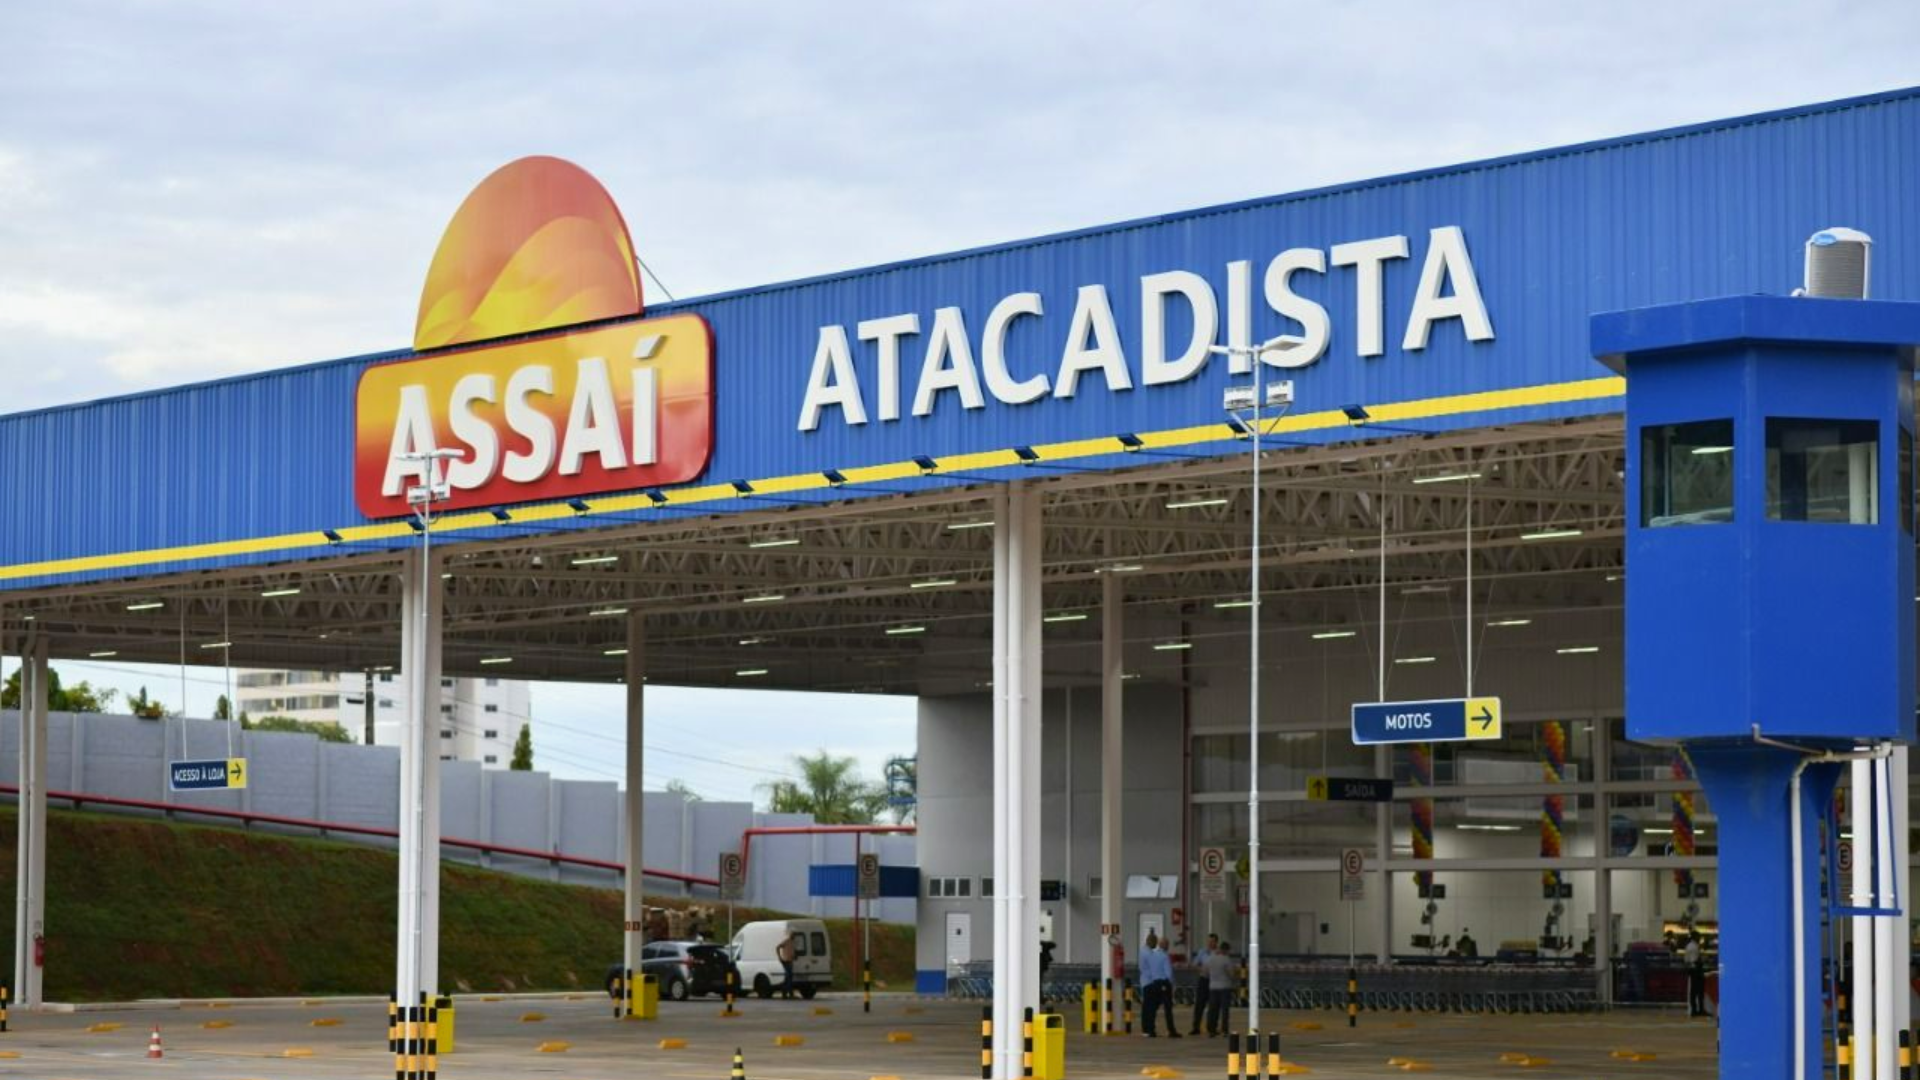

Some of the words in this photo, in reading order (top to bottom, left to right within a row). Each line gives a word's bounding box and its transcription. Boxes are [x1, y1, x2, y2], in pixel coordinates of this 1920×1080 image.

[797, 225, 1496, 432] ATACADISTA
[381, 334, 668, 498] ASSAÍ
[1385, 713, 1432, 730] MOTOS
[174, 769, 200, 782] ACESSO
[208, 767, 226, 780] LOJA
[1208, 855, 1218, 870] E
[1349, 855, 1358, 870] E
[1840, 849, 1850, 865] E
[728, 859, 737, 873] E
